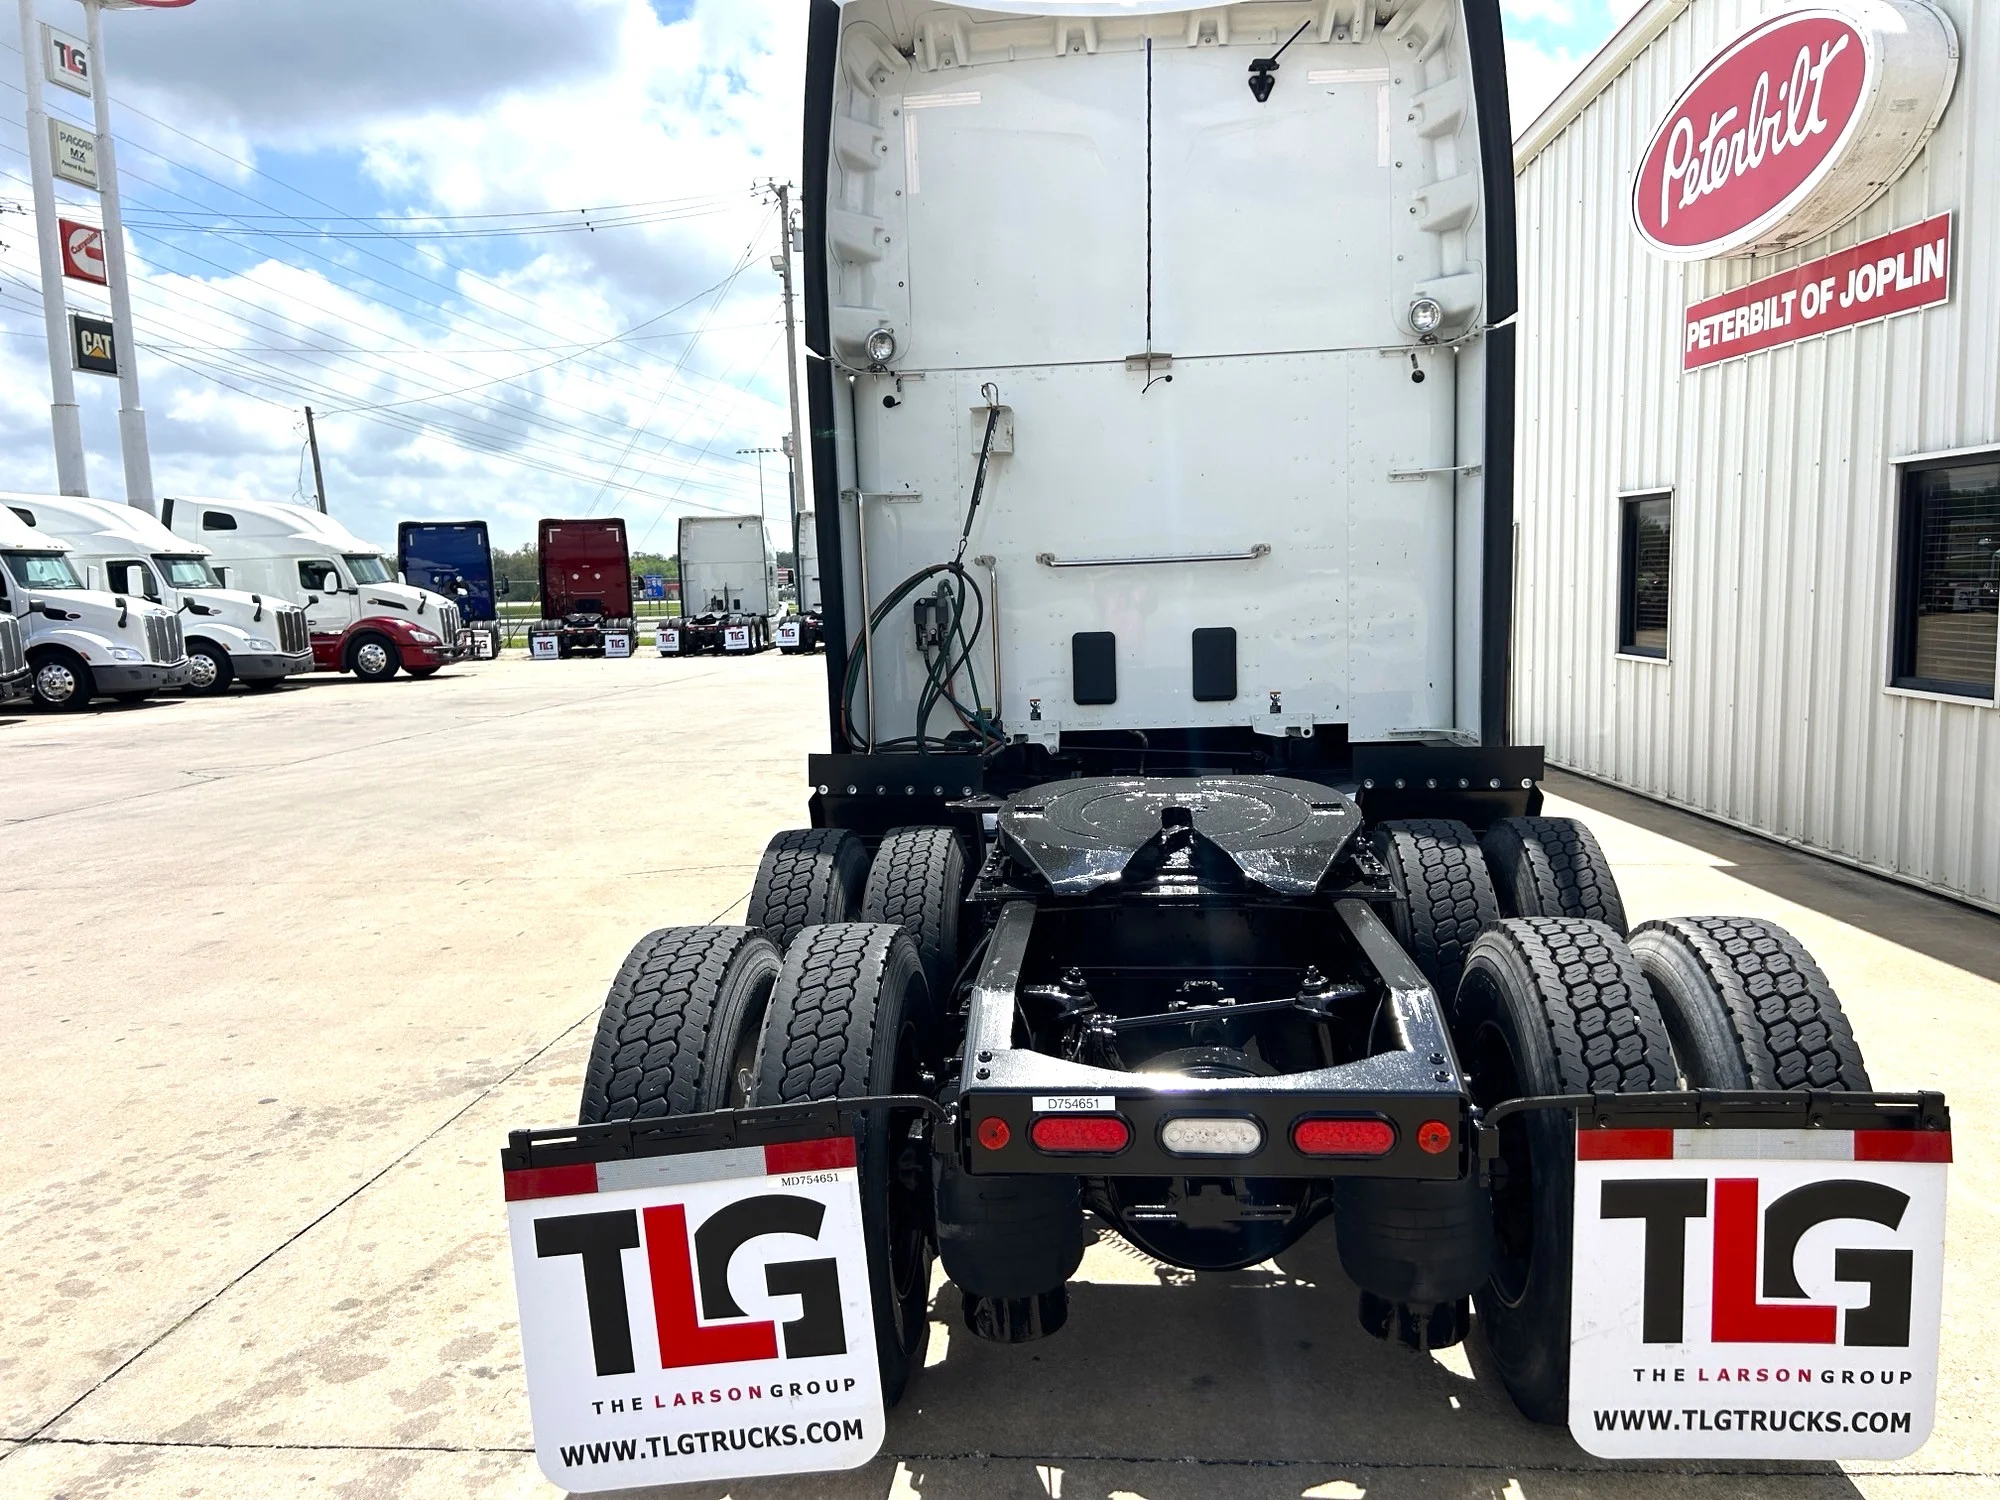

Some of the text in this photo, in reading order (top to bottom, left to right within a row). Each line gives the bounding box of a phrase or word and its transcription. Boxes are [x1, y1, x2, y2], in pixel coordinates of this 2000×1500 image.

[53, 40, 87, 77] TLG
[60, 131, 94, 151] PACCAR
[1661, 34, 1849, 228] Peterbilt
[70, 147, 86, 161] MX
[1686, 239, 1945, 352] PETERBILT OF JOPLIN
[80, 330, 112, 359] CAT
[537, 641, 554, 651] TLG
[609, 639, 626, 649] TLG
[660, 633, 675, 643] TLG
[728, 631, 745, 641] TLG
[1048, 1098, 1099, 1109] D754651
[781, 1173, 840, 1187] MD754651
[1600, 1178, 1914, 1347] TLG
[533, 1194, 848, 1377] TLG
[1633, 1368, 1913, 1385] THE LARSON GROUP
[592, 1377, 857, 1415] THE LARSON GROUP
[1593, 1410, 1912, 1434] WWW.TLGTRUCKS.COM
[559, 1418, 864, 1468] WWW.TLGTRUCKS.COM
